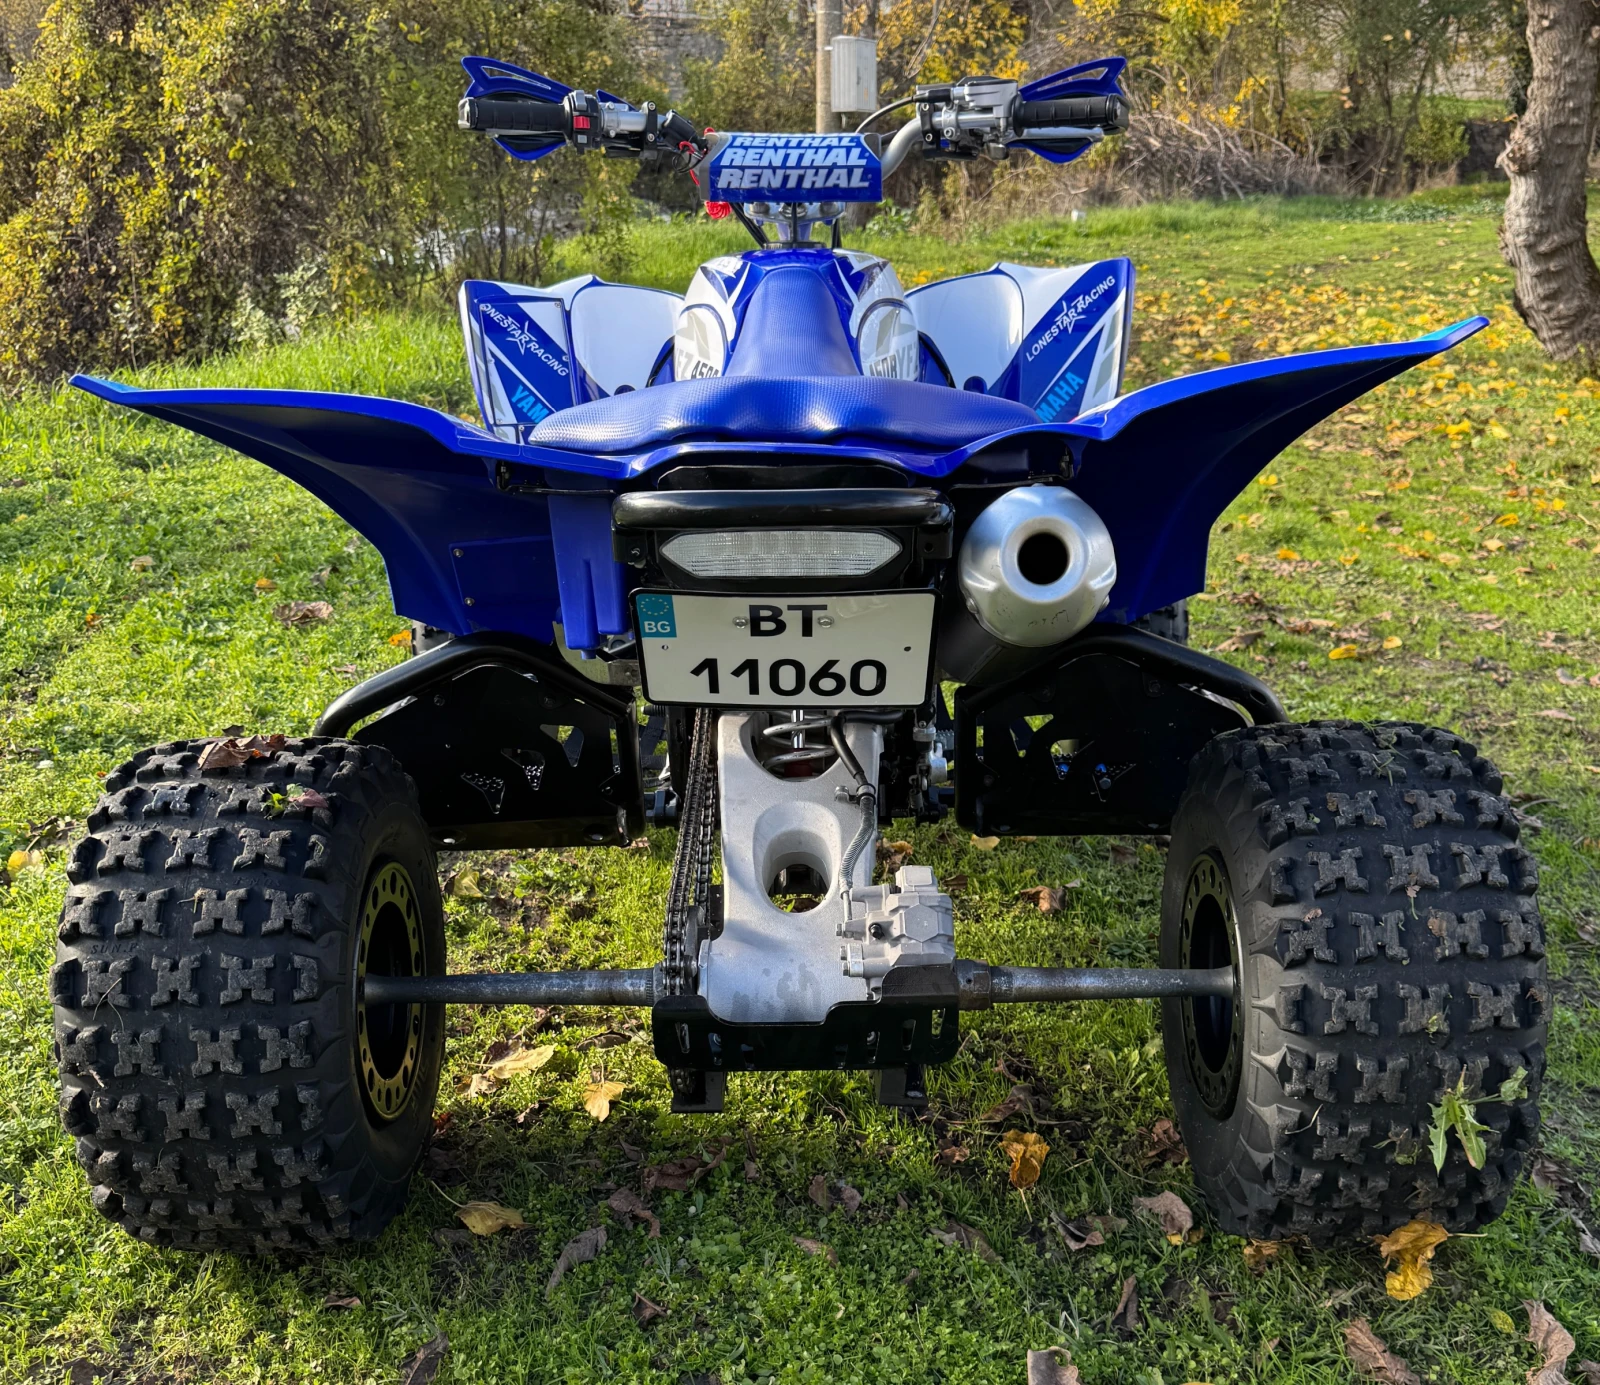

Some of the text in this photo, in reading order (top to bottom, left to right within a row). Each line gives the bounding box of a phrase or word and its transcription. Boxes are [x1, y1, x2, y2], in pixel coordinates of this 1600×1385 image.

[720, 147, 869, 167] RENTHAL
[732, 136, 857, 147] RENTHAL
[717, 167, 870, 189] RENTHAL
[1026, 275, 1116, 362] LONESTAR RACING
[474, 299, 569, 377] ONESTAR RACING
[511, 385, 550, 424] YAM
[1036, 371, 1084, 423] MAHA
[644, 620, 671, 634] BG
[748, 603, 828, 638] BT
[689, 657, 887, 697] 11060
